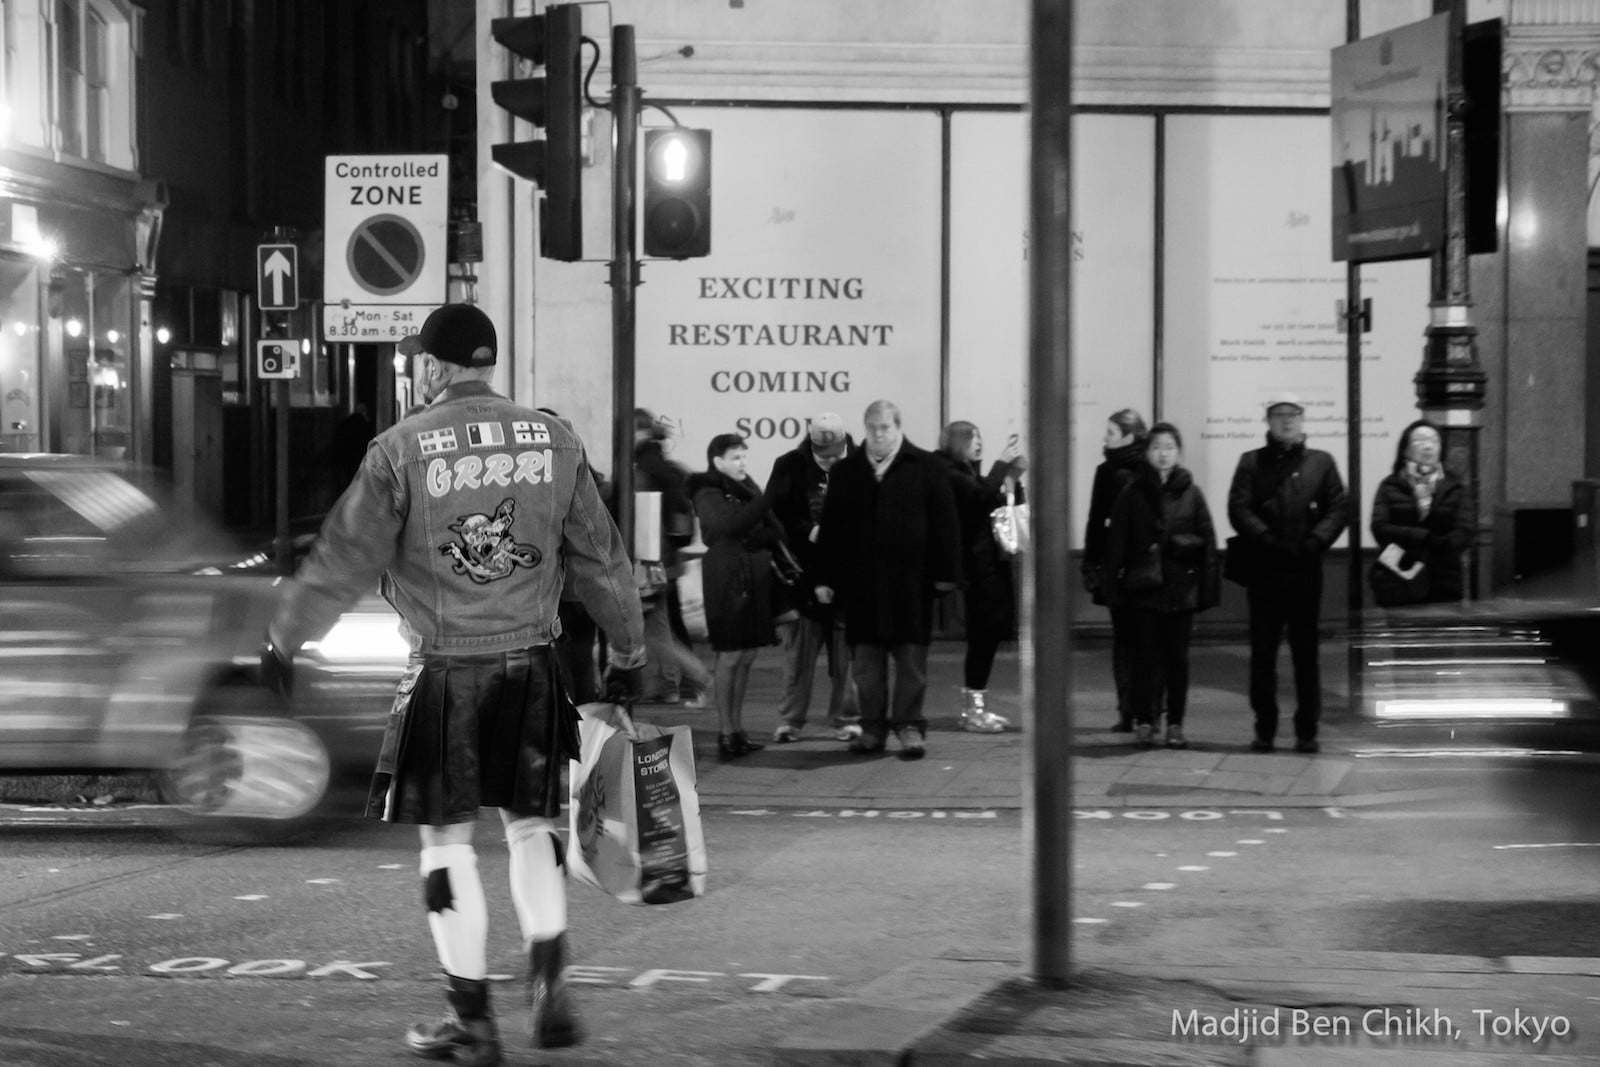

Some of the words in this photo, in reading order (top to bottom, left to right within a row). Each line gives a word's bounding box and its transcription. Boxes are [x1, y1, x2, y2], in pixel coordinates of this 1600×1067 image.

[335, 162, 439, 178] Controlled
[350, 186, 423, 205] ZONE
[698, 277, 864, 300] EXCITING
[355, 311, 381, 321] Mon
[392, 311, 413, 321] Sat
[329, 326, 358, 336] 8.30
[361, 328, 379, 336] am
[668, 324, 894, 346] RESTAURANT
[710, 370, 851, 393] COMING
[426, 449, 553, 497] GRRR!
[484, 965, 830, 993] EFT
